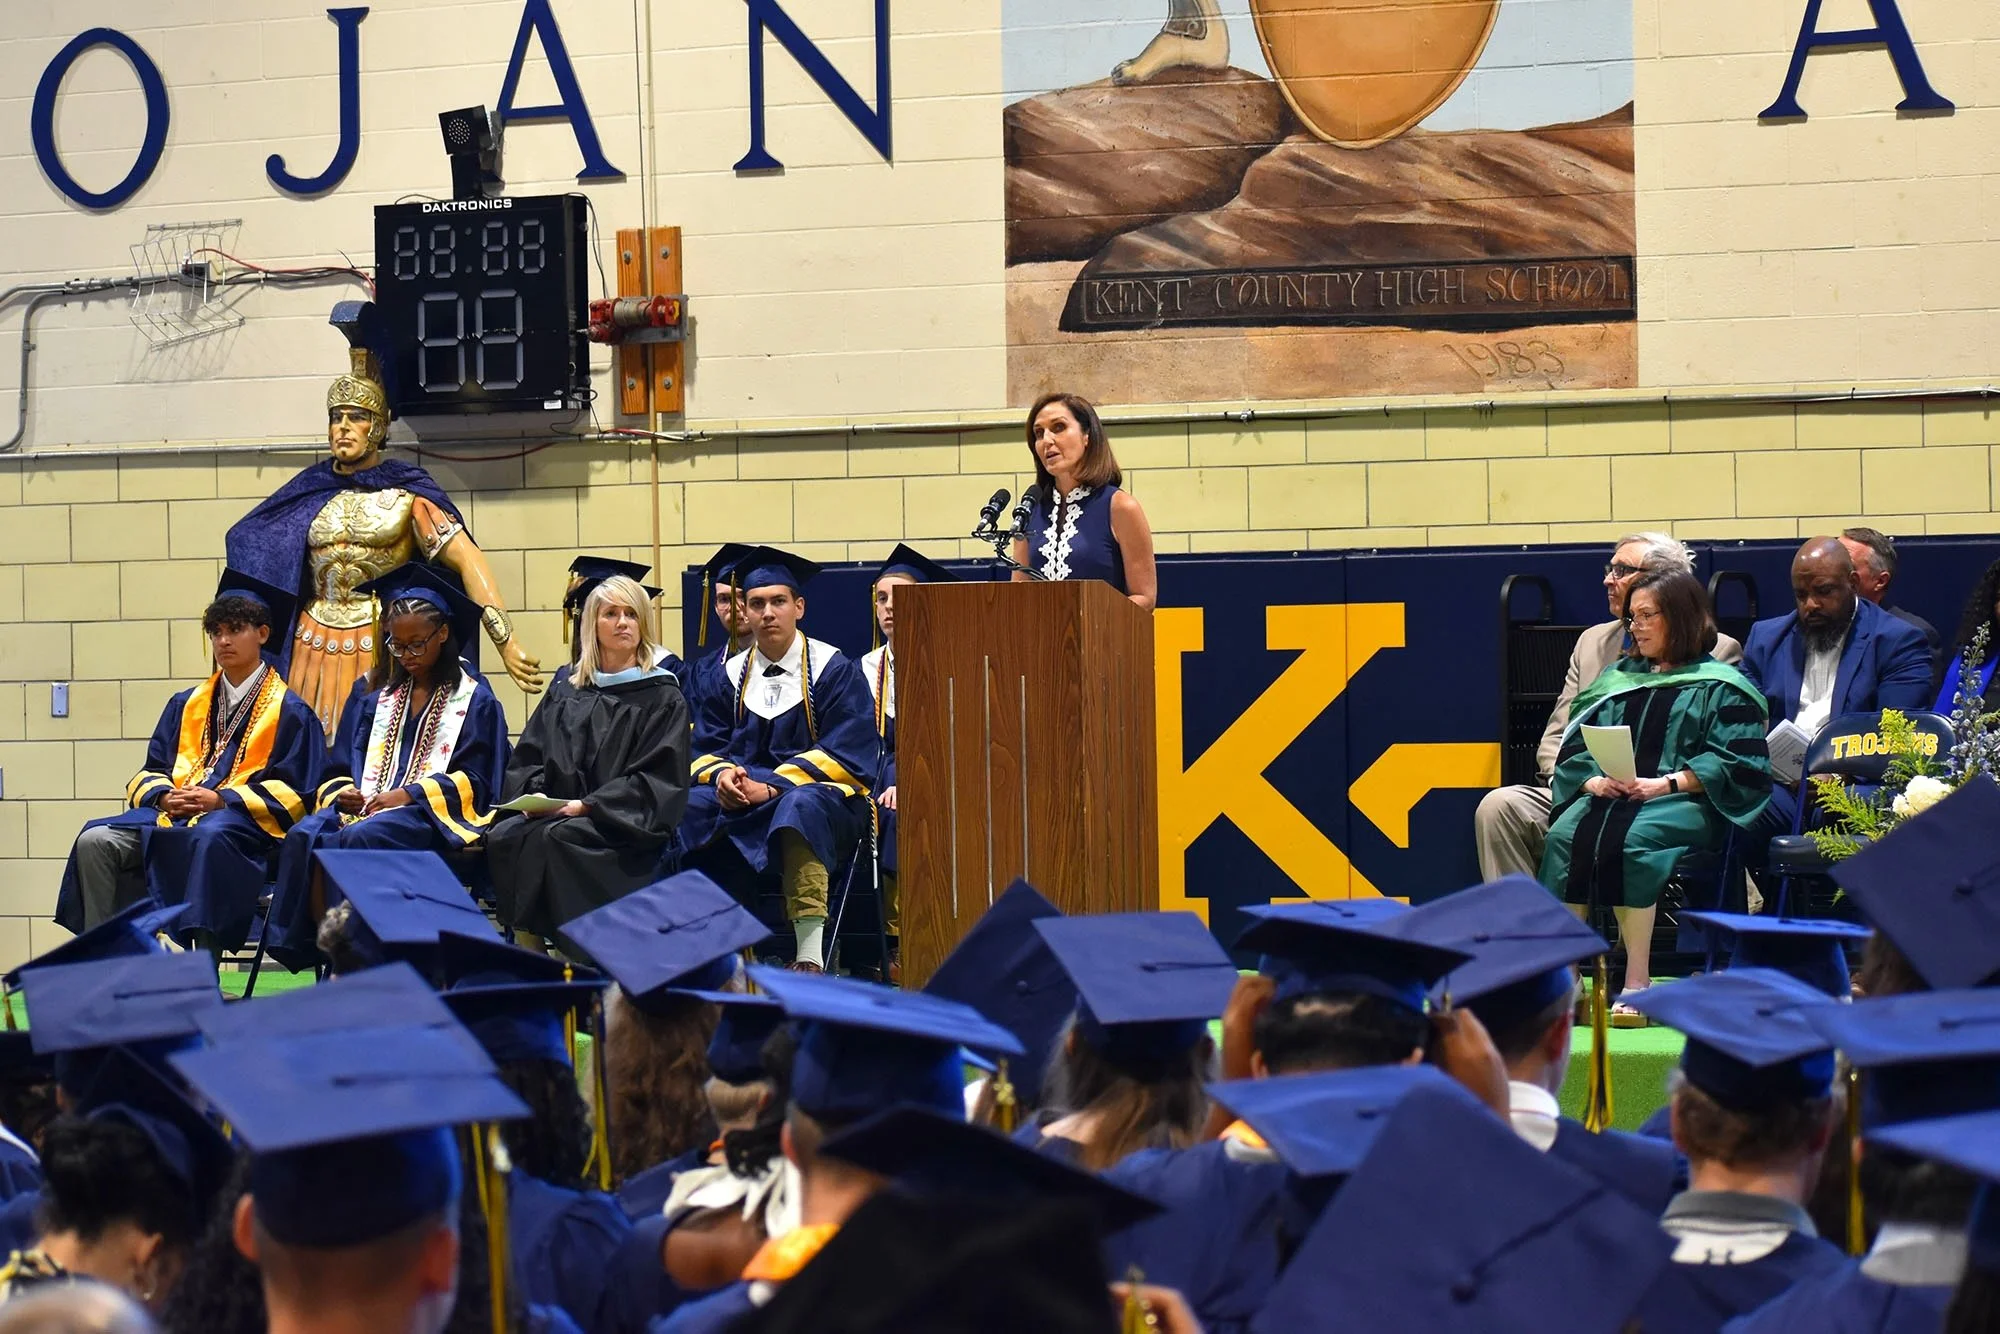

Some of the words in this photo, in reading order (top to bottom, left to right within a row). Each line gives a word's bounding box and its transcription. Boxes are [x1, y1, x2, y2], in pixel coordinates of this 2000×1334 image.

[422, 199, 513, 213] DAKTRONICS
[1092, 278, 1191, 315] KENT
[1215, 273, 1363, 309] COUNTY
[1375, 268, 1466, 307] HIGH
[1487, 264, 1627, 303] SCHOOL
[1442, 340, 1565, 377] 1983
[1831, 732, 1939, 759] TROJNS
